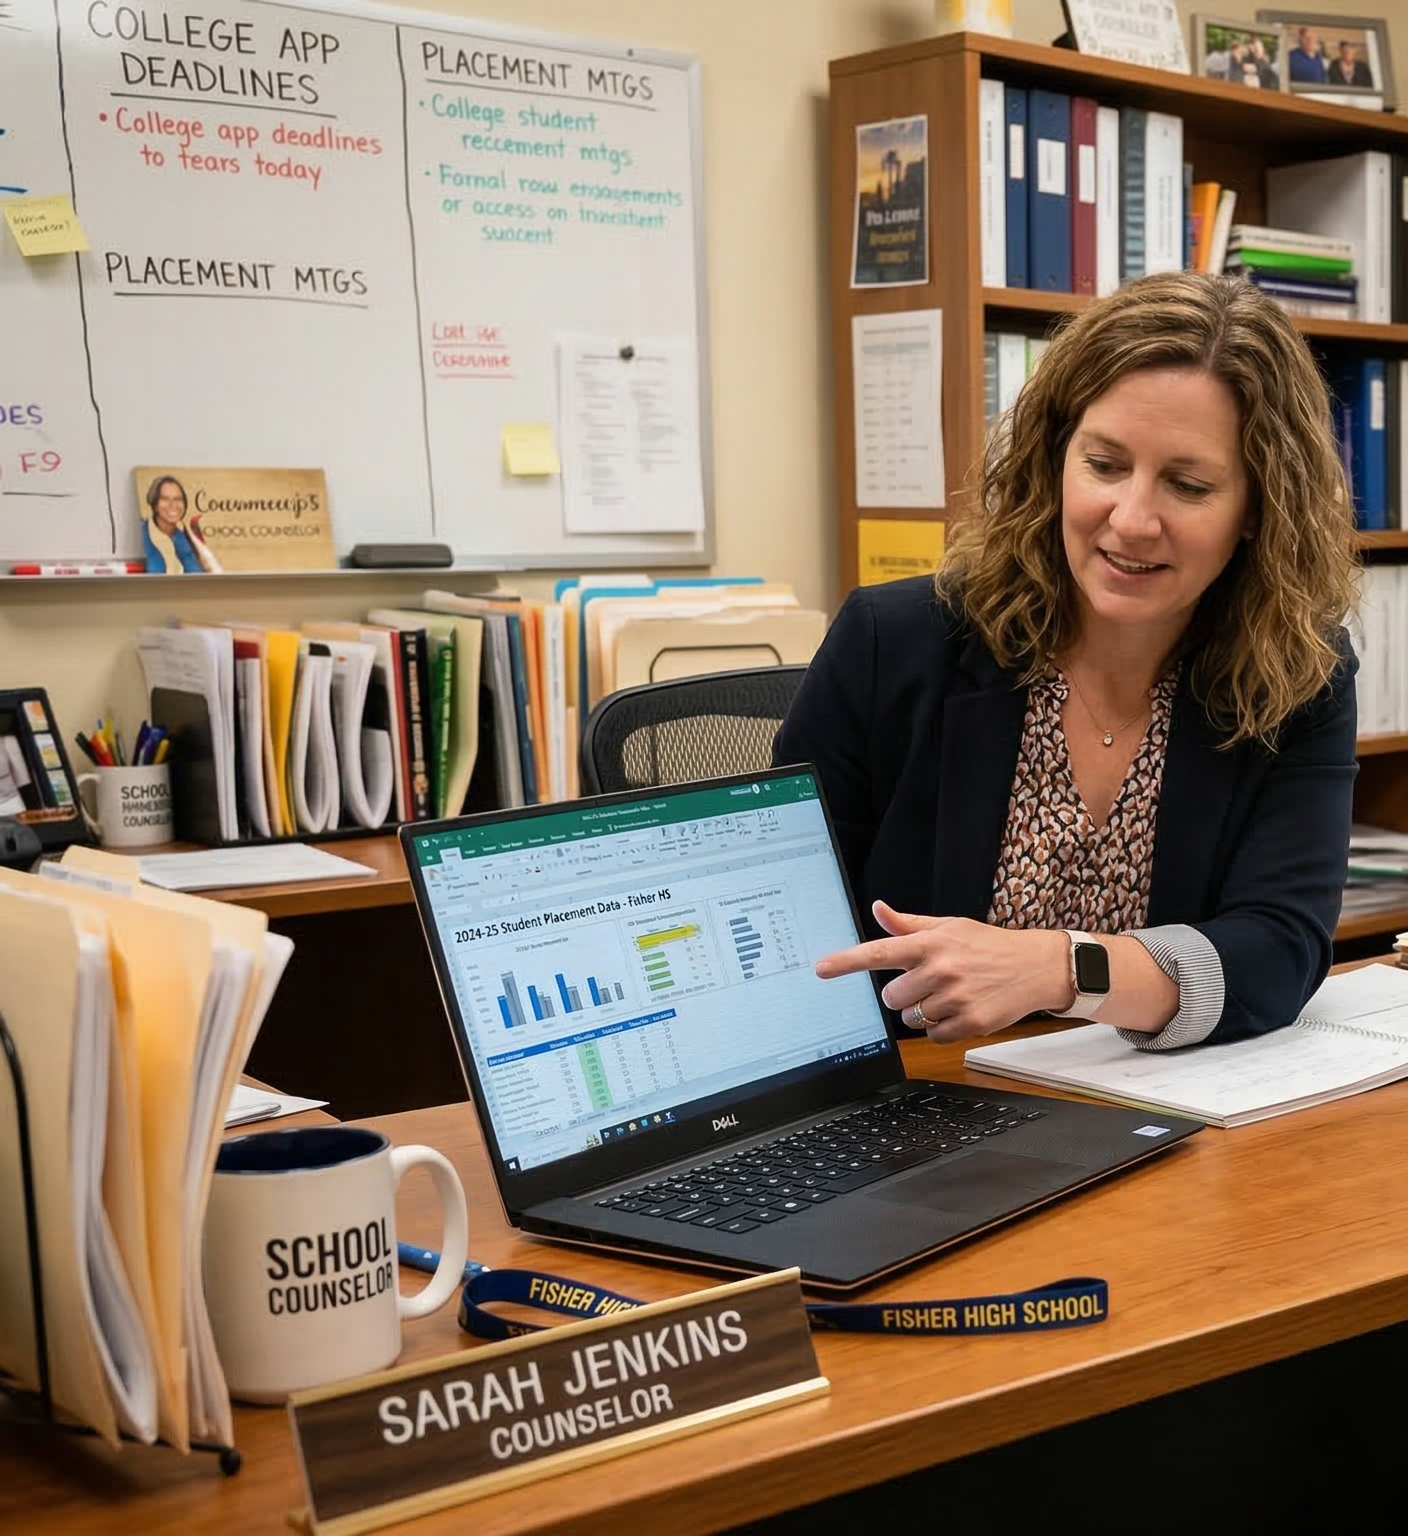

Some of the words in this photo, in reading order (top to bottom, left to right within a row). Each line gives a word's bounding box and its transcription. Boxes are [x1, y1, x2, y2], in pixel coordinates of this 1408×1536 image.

[88, 0, 256, 54] COLLEGE
[279, 28, 340, 64] APP
[120, 52, 320, 105] DEADLINES
[421, 41, 572, 88] PLACEMENT
[587, 69, 654, 100] MTGS
[115, 106, 206, 148] College
[217, 122, 260, 150] app
[272, 123, 383, 156] deadlines
[431, 93, 506, 131] College
[518, 104, 598, 133] student
[140, 143, 165, 168] to
[255, 153, 322, 191] today
[579, 143, 634, 175] mtgs
[105, 252, 276, 291] PLACEMENT
[294, 266, 369, 296] MTGS
[203, 525, 247, 538] CHOOL
[454, 925, 499, 944] 2024-25
[501, 915, 543, 935] Student
[543, 903, 597, 925] Placement
[597, 899, 621, 915] Data
[657, 888, 672, 901] HS
[711, 1113, 740, 1132] DELL
[266, 1216, 391, 1281] SCHOOL
[268, 1261, 394, 1316] COUNSELOR
[529, 1277, 596, 1312] FISHER
[882, 1306, 958, 1329] FISHER
[964, 1302, 1016, 1328] HIGH
[1023, 1293, 1104, 1324] SCHOOL
[379, 1361, 546, 1444] SARAH
[563, 1309, 750, 1397] JENKINS
[489, 1383, 675, 1460] COUNSELOR
